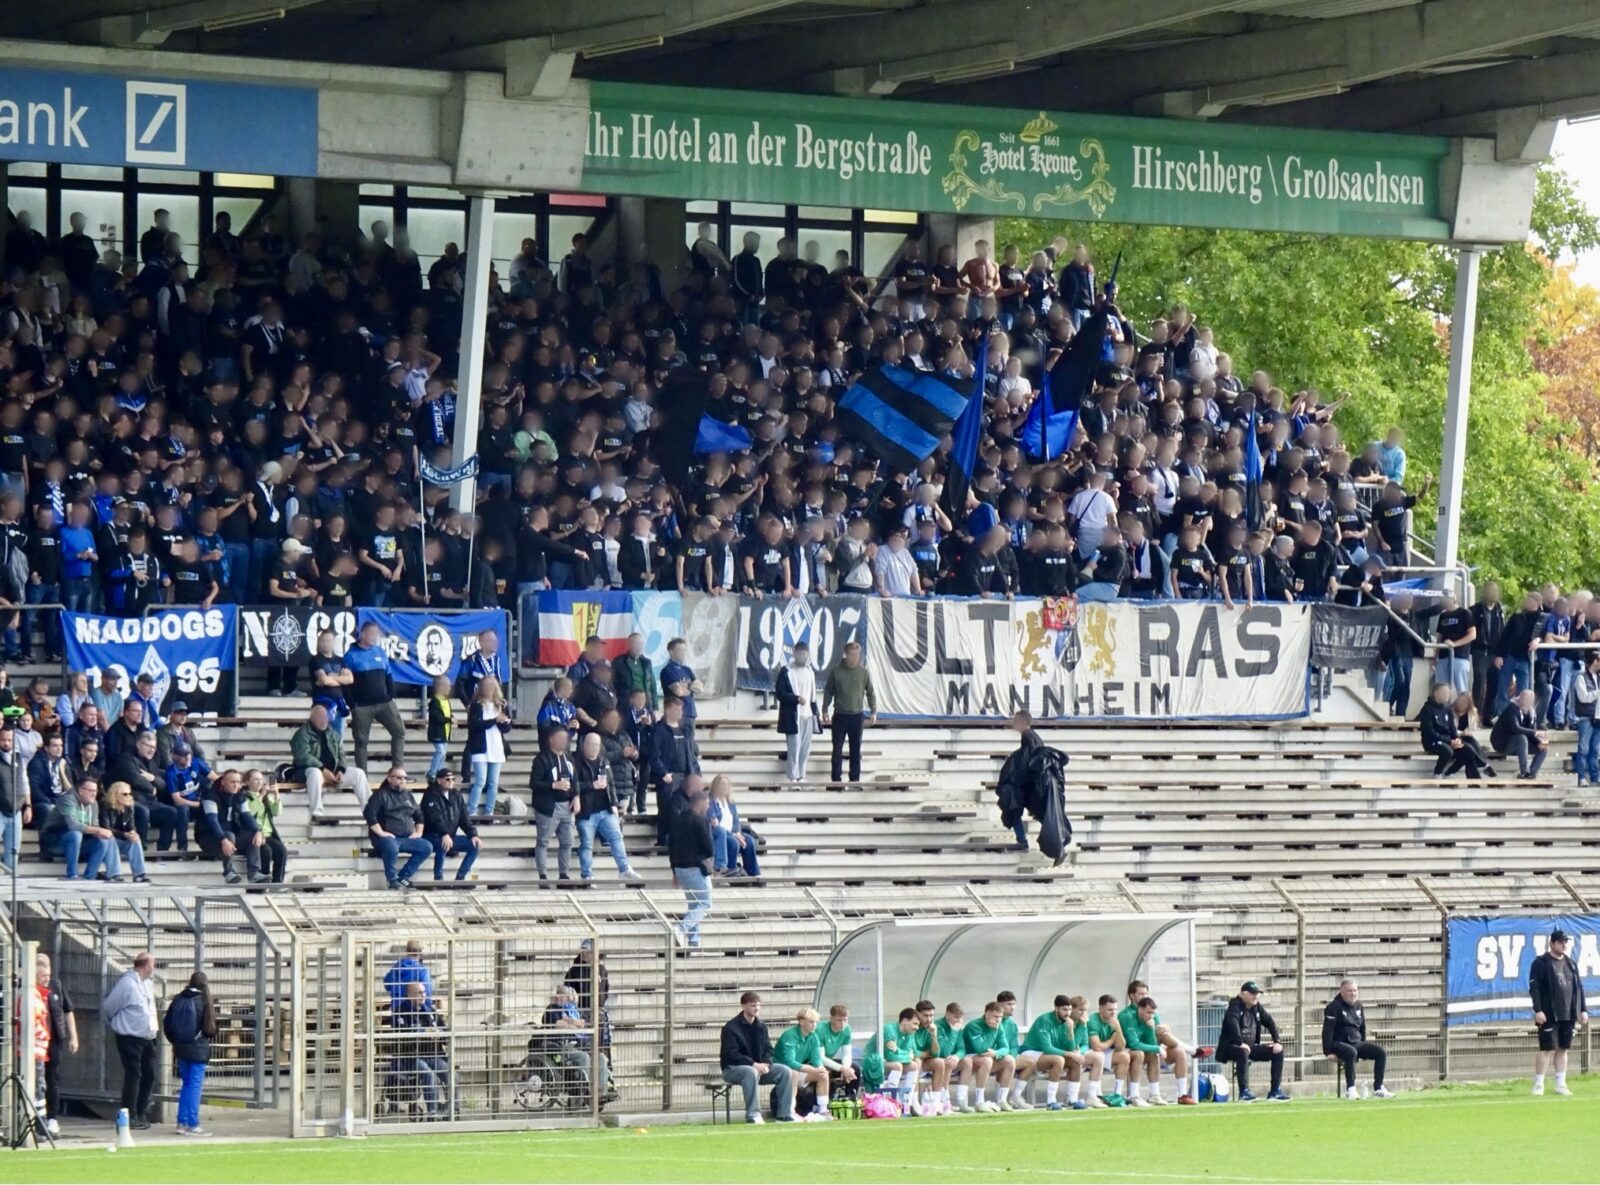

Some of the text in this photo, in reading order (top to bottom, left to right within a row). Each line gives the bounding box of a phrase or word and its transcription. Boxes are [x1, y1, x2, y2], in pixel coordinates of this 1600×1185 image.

[630, 113, 702, 162] Hotel
[708, 130, 738, 164] an
[746, 121, 786, 168] der
[794, 123, 932, 179] Bergstraße
[999, 131, 1016, 144] Seit
[980, 141, 1082, 181] Hotel Krone
[1131, 145, 1262, 204] Hirschberg
[1283, 155, 1425, 205] Großsachsen
[75, 609, 225, 644] MADDOGS
[946, 680, 1171, 716] MANNHEIM
[1477, 935, 1525, 980] SV
